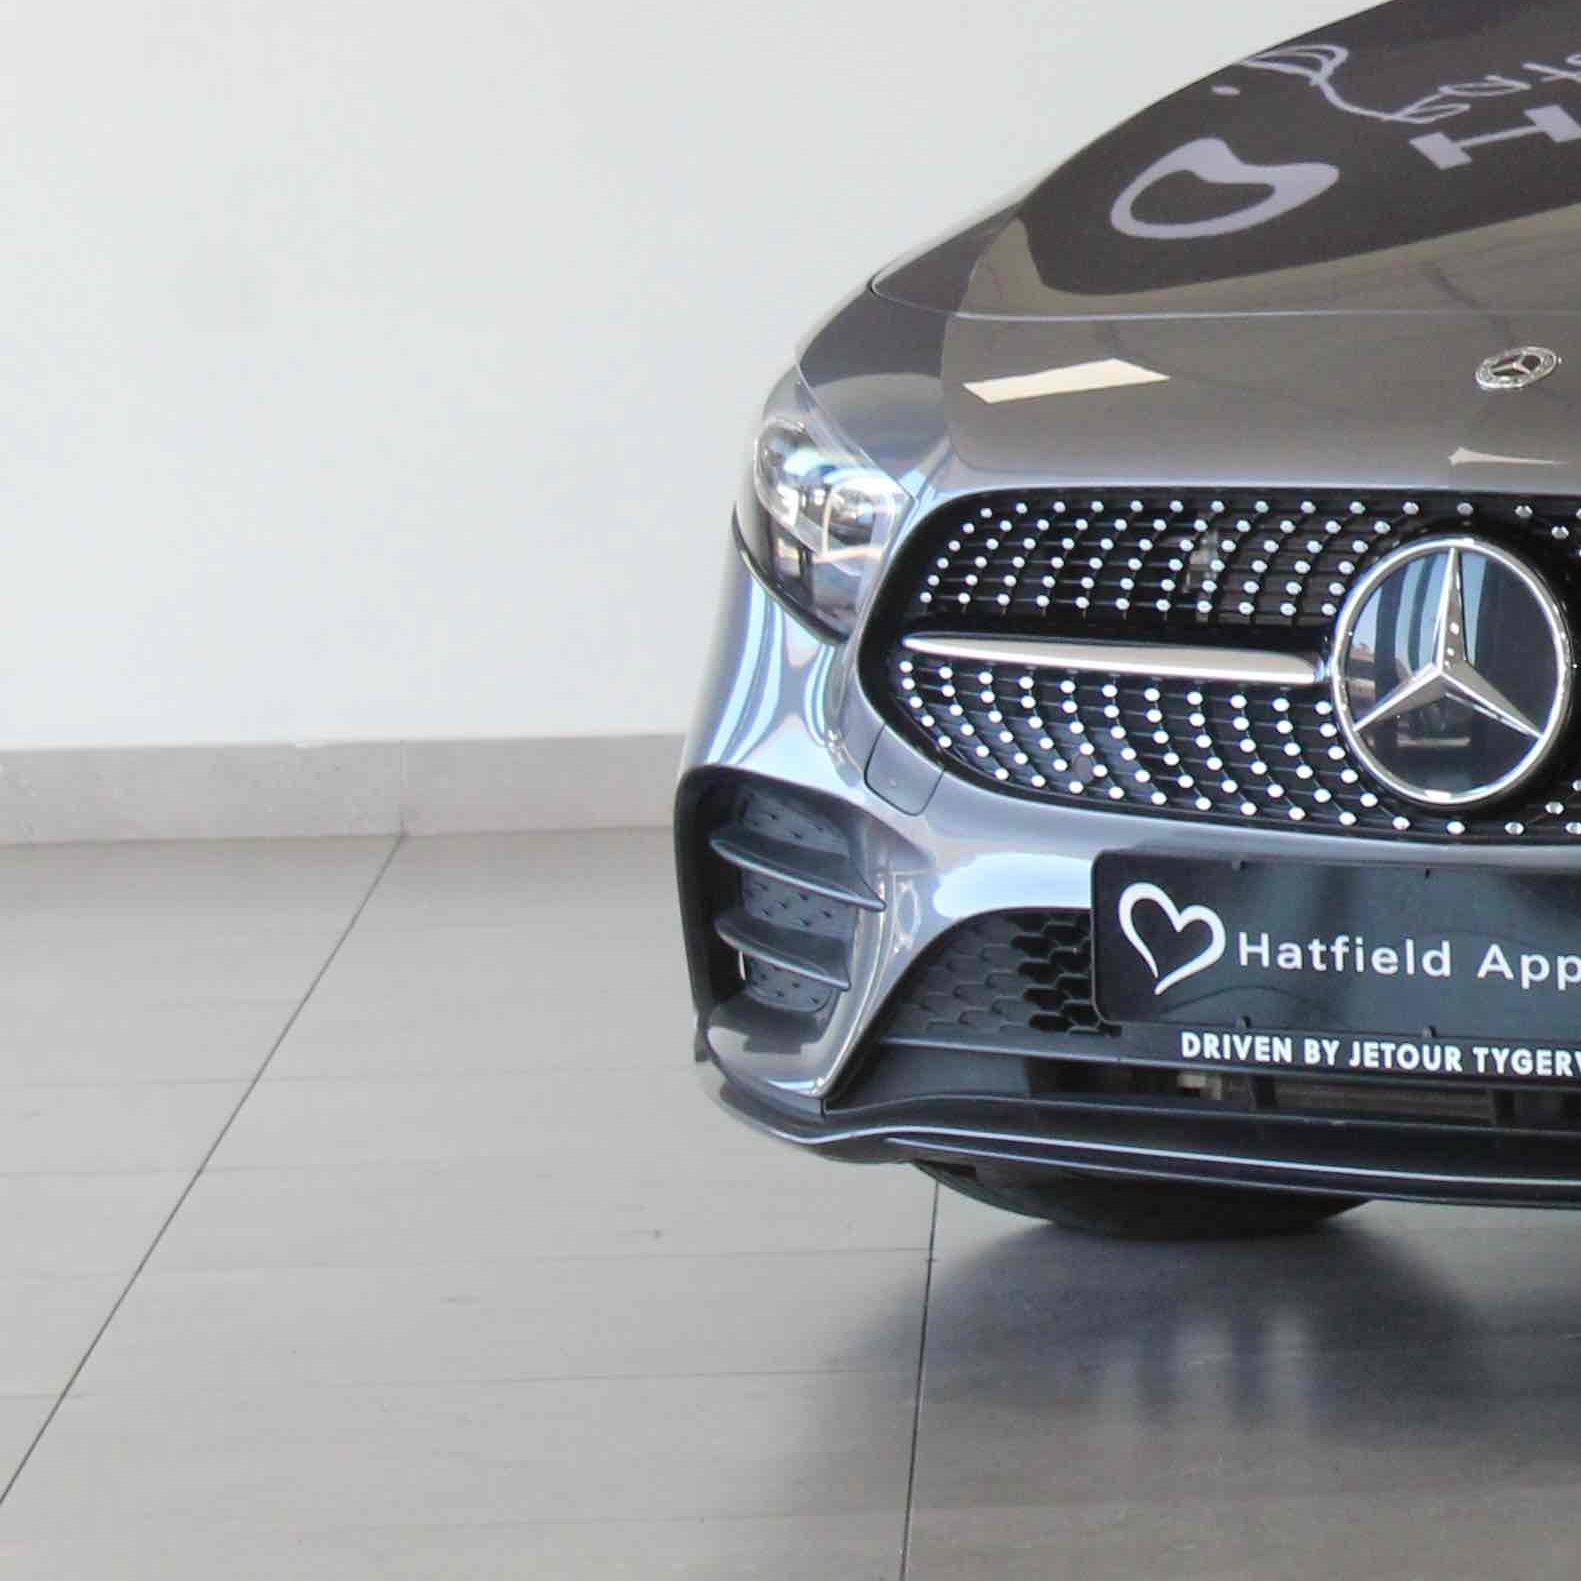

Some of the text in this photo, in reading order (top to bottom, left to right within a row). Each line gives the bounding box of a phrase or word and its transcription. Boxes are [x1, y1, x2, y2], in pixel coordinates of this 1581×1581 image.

[1238, 931, 1452, 978] Hatfield
[1181, 1031, 1292, 1063] DRIVEN
[1303, 1038, 1340, 1066] BY
[1348, 1040, 1463, 1073] JETOUR
